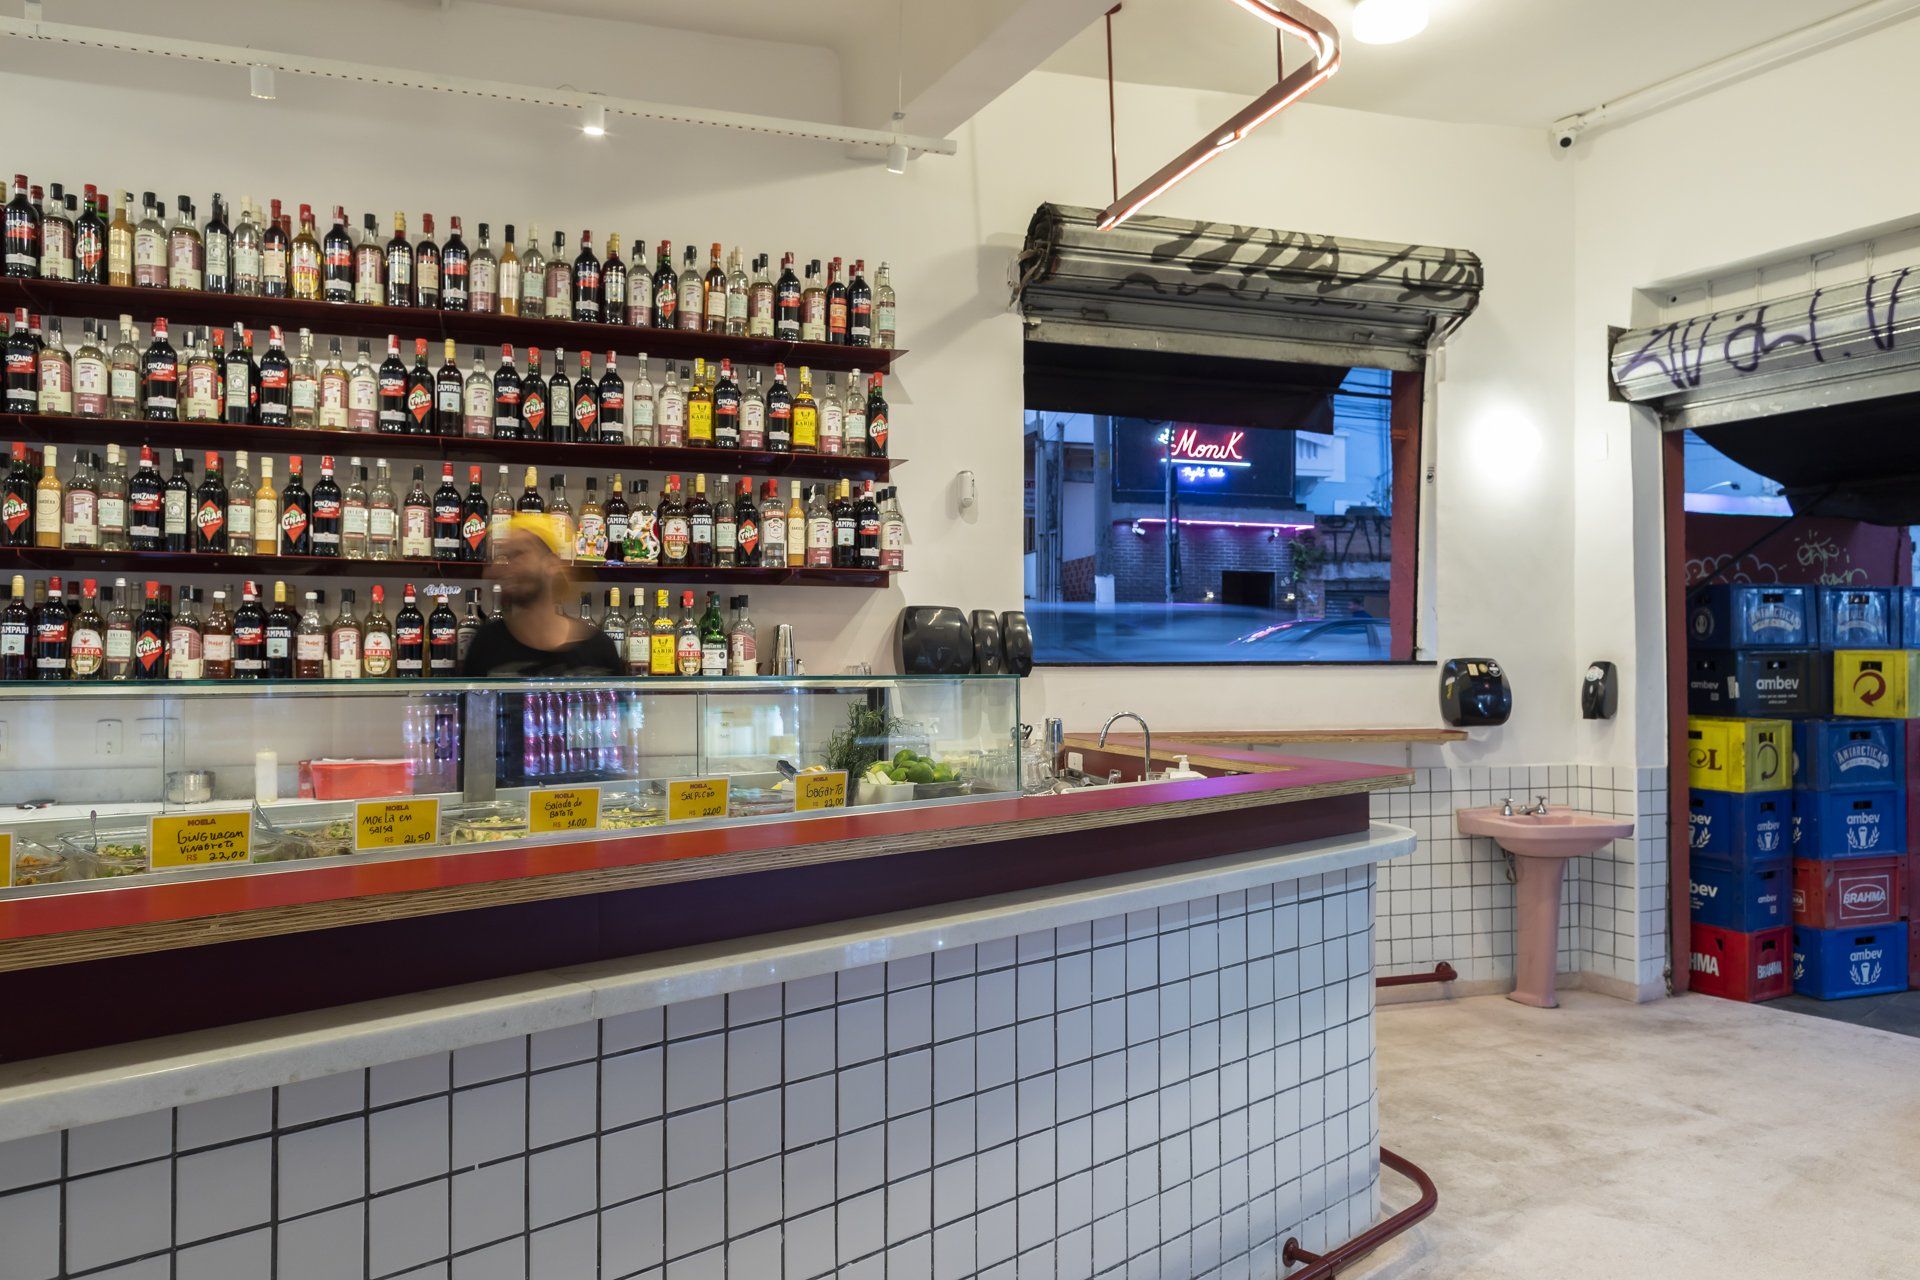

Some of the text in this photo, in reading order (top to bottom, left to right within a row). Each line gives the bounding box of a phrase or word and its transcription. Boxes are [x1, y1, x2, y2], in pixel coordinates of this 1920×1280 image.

[5, 355, 33, 363] CINZANO
[148, 362, 174, 371] CINZANO
[380, 378, 404, 386] CINZANO
[408, 393, 431, 410] CYNAR
[523, 402, 545, 418] CYNAR
[575, 403, 597, 418] CYNAR
[131, 492, 158, 501] CINZANO
[314, 500, 339, 508] CINZANO
[435, 505, 459, 513] CINZANO
[197, 510, 222, 527] CYNAR
[281, 513, 306, 530] CYNAR
[463, 522, 486, 538] CYNAR
[234, 627, 261, 636] CINZANO
[396, 627, 421, 636] CINZANO
[136, 640, 161, 658] CYNAR
[1690, 681, 1719, 690] ambev
[1756, 675, 1799, 690] ambev
[1837, 745, 1881, 764] ANTARCTICA
[1846, 812, 1880, 825] ambev
[1757, 820, 1780, 832] ambev
[1757, 894, 1777, 904] ambev
[1843, 890, 1886, 905] BRAHMA
[1849, 948, 1882, 962] ambev
